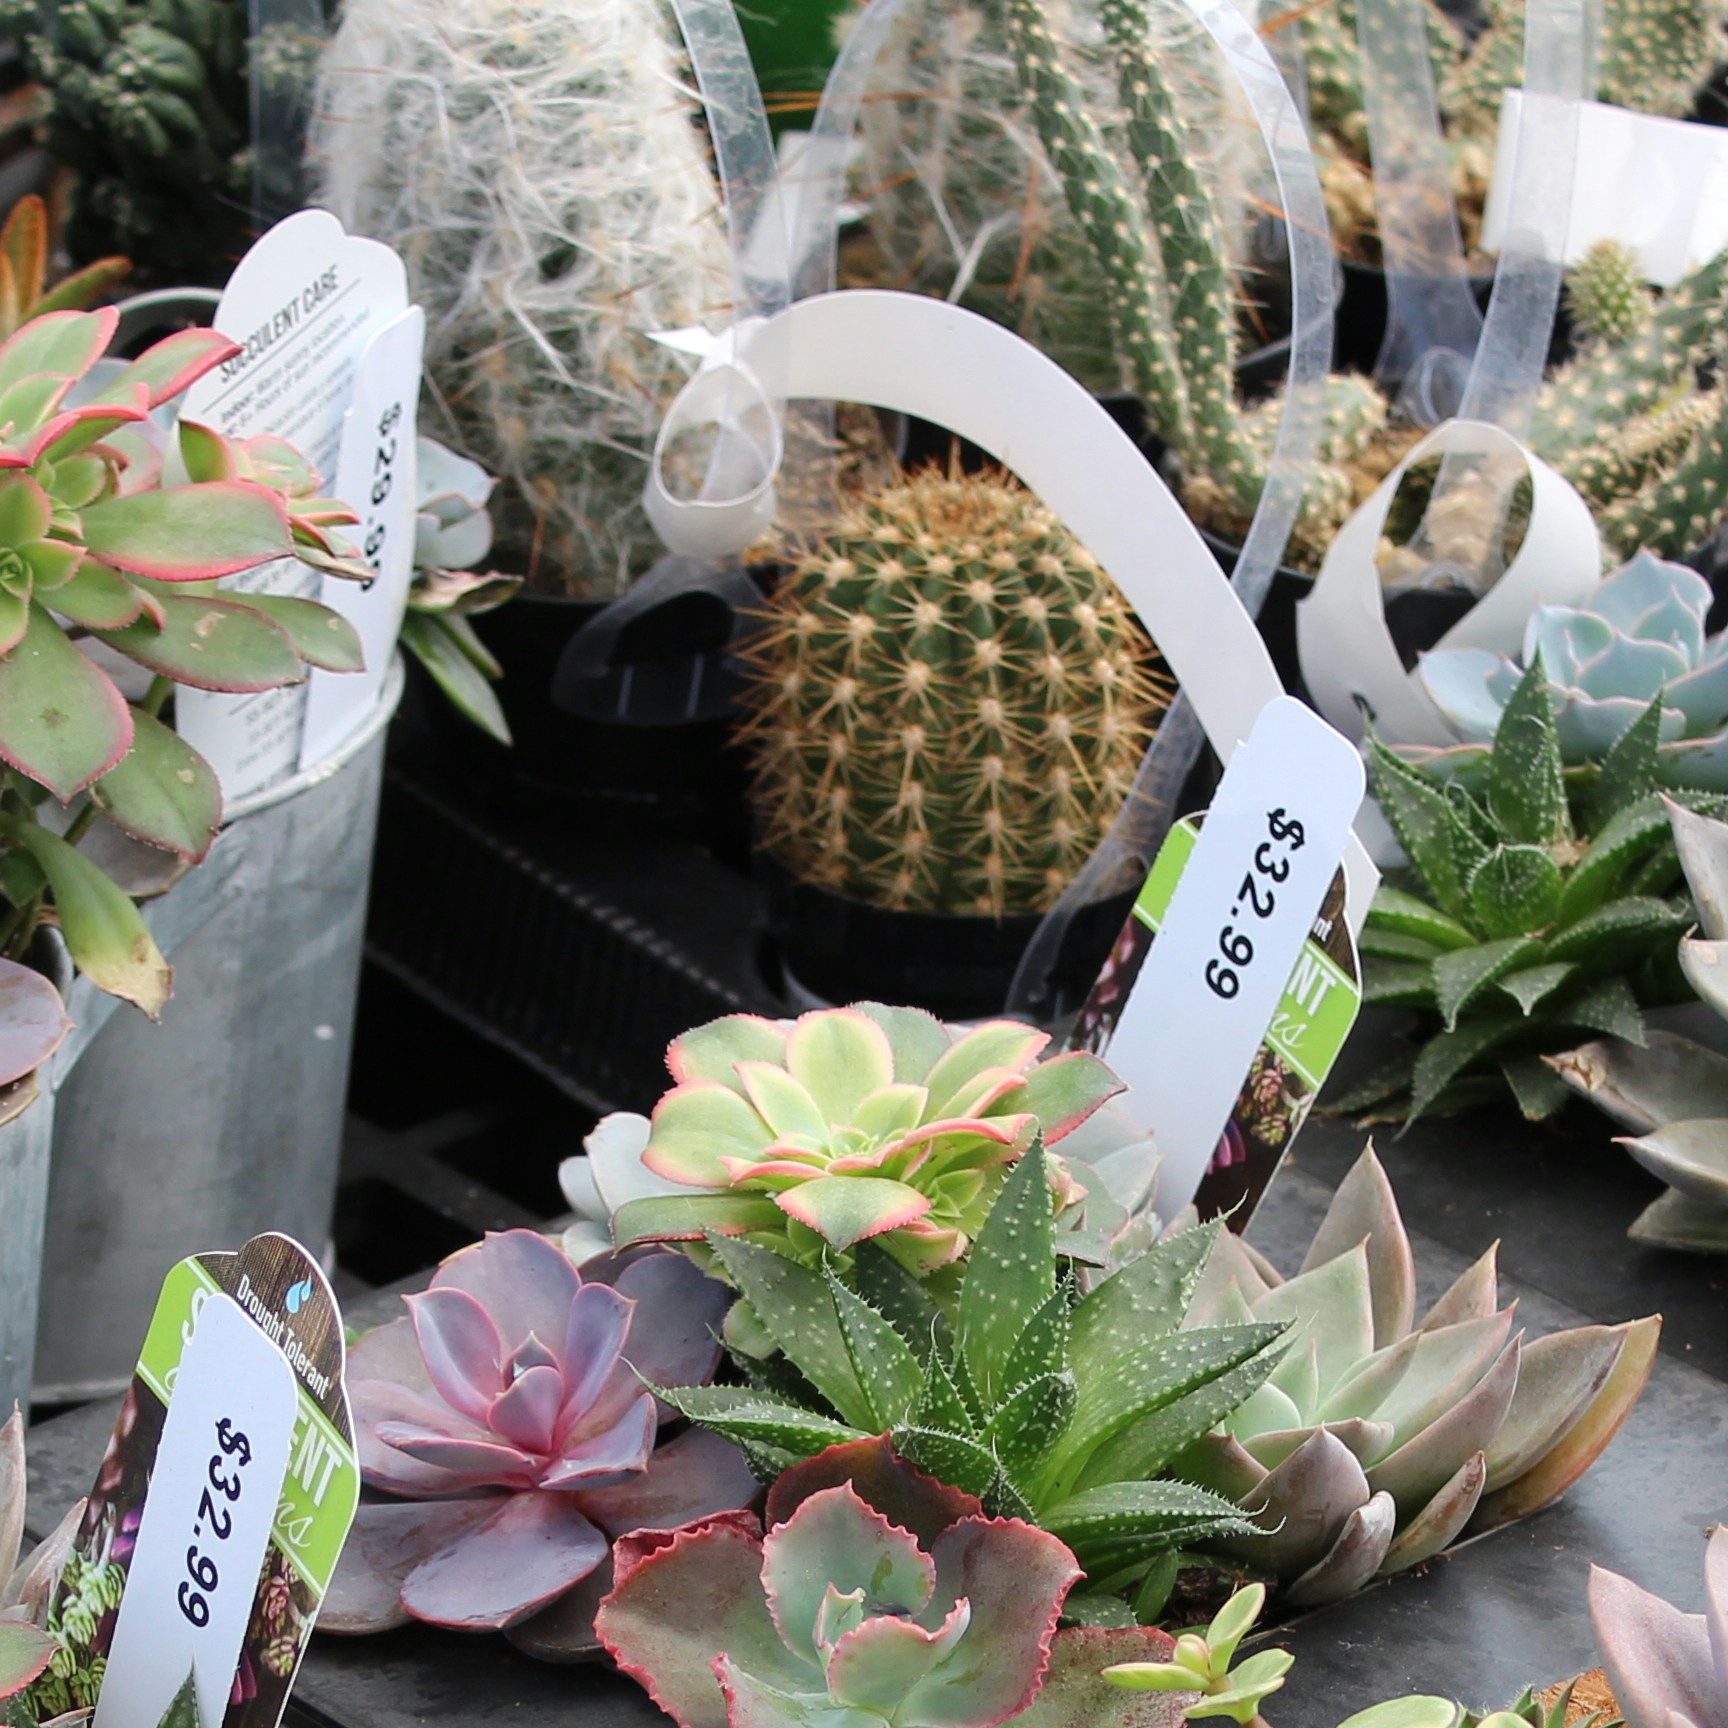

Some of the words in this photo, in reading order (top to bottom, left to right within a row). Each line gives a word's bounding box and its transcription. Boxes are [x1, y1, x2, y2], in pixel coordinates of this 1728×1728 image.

[302, 263, 339, 314] CARE
[1205, 807, 1306, 1000] $32.99
[236, 1272, 282, 1345] Drought
[282, 1326, 330, 1401] Tolerant
[177, 1416, 252, 1629] $32.99
